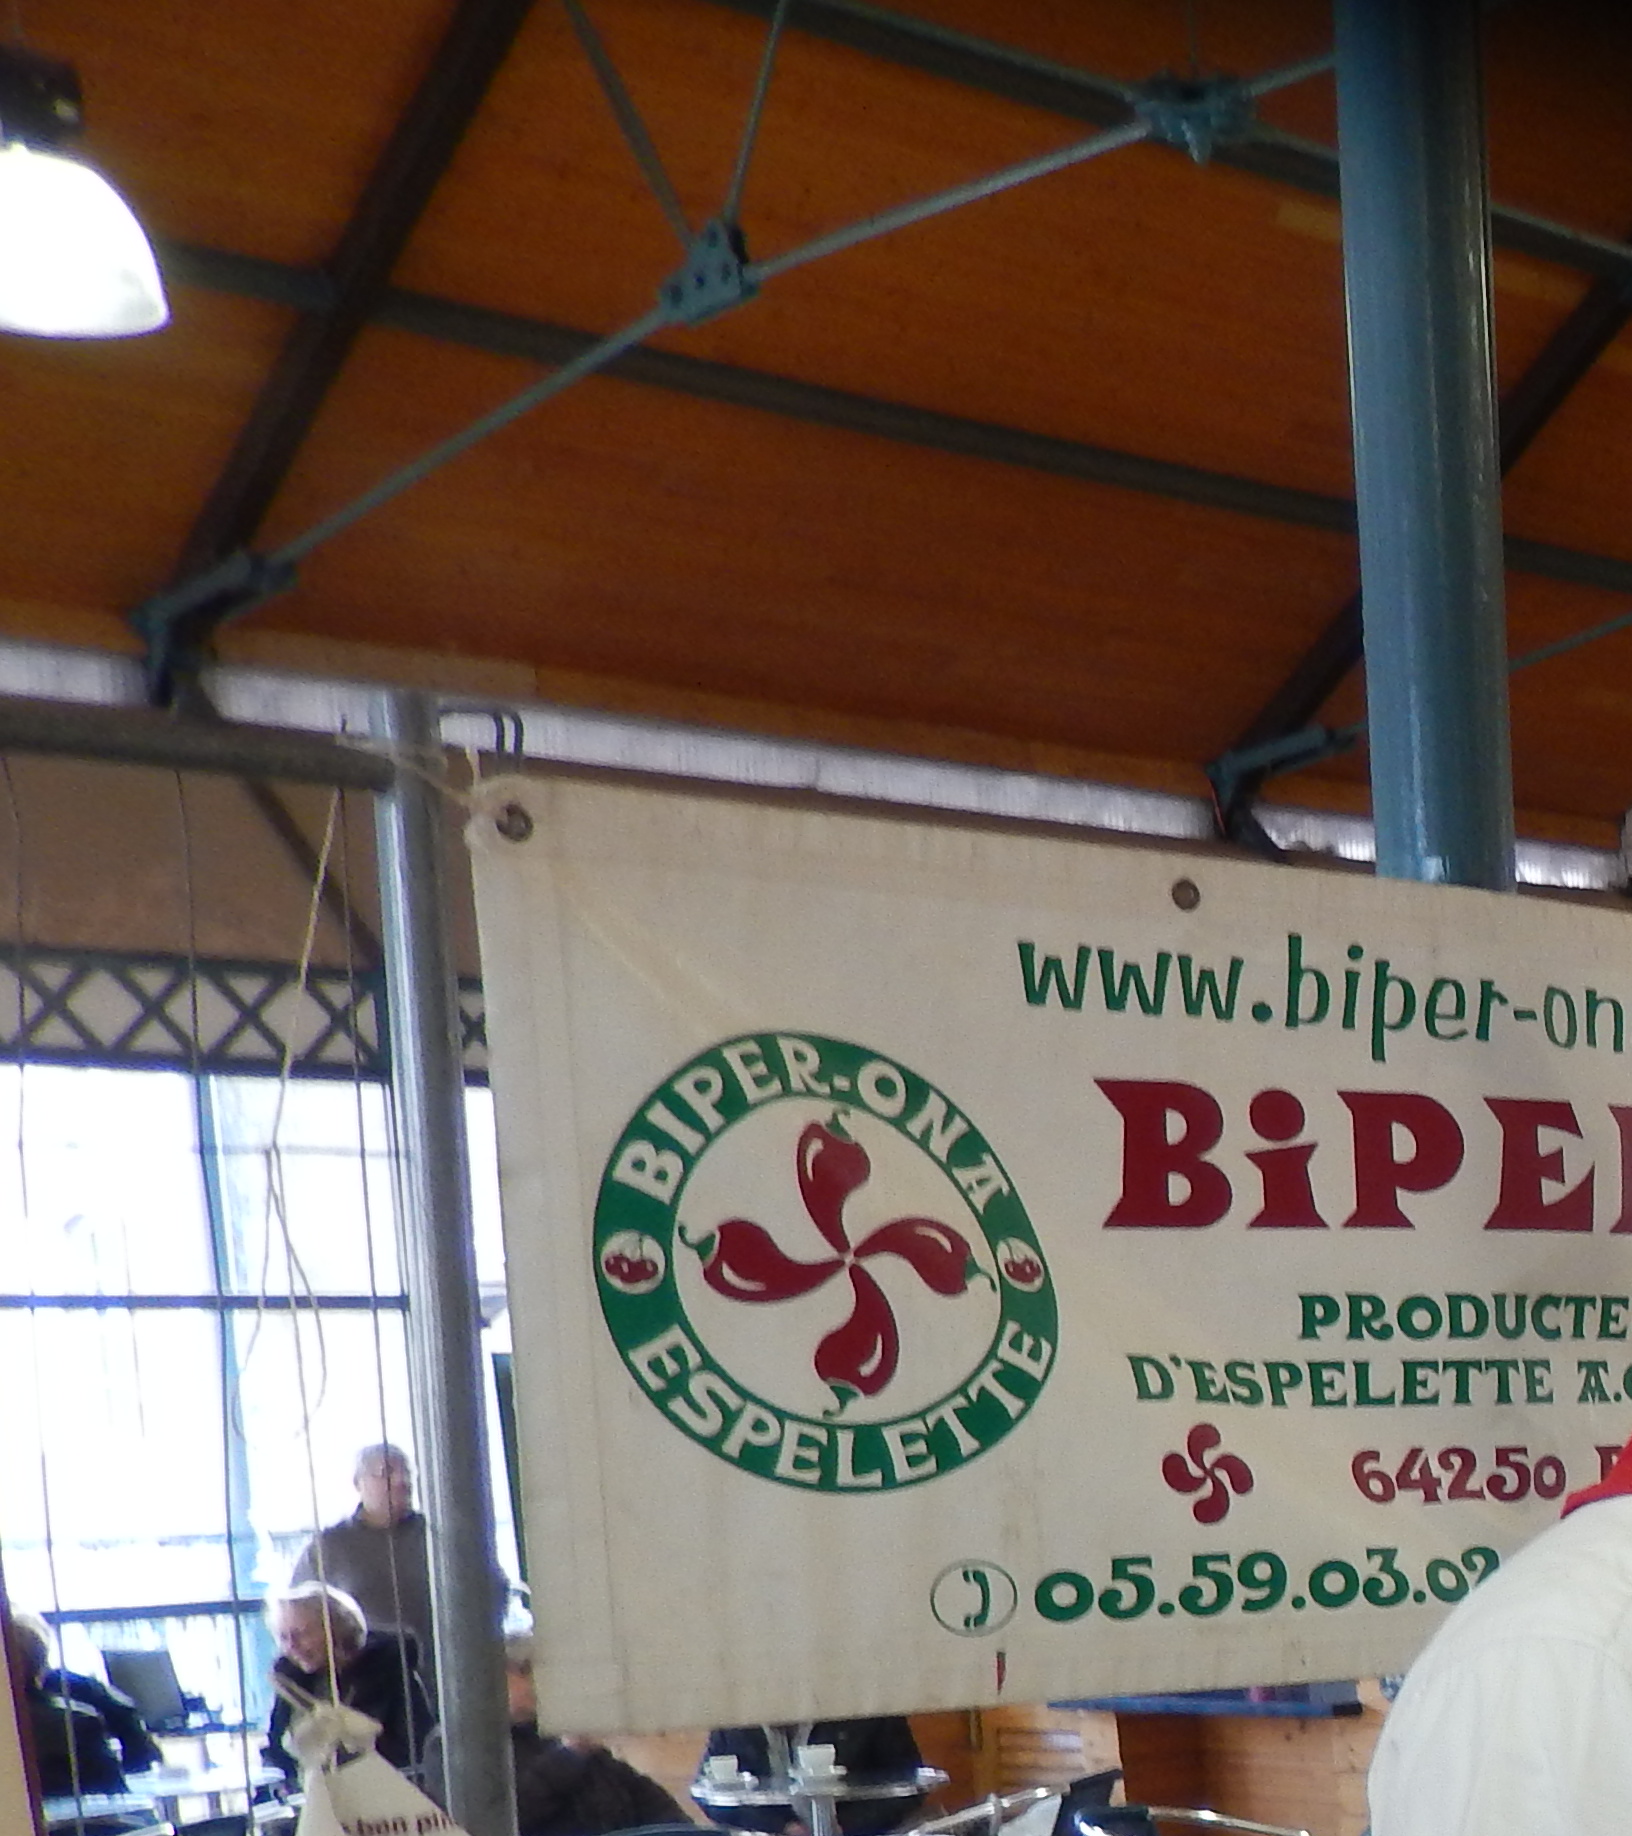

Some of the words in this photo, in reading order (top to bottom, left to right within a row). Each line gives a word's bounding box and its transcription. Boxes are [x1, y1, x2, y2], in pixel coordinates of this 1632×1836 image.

[612, 1034, 1011, 1213] BIPER-ONA
[628, 1319, 1053, 1488] ESPELETTE
[1126, 1354, 1553, 1406] D'ESPELETTE
[1351, 1446, 1566, 1505] 64250
